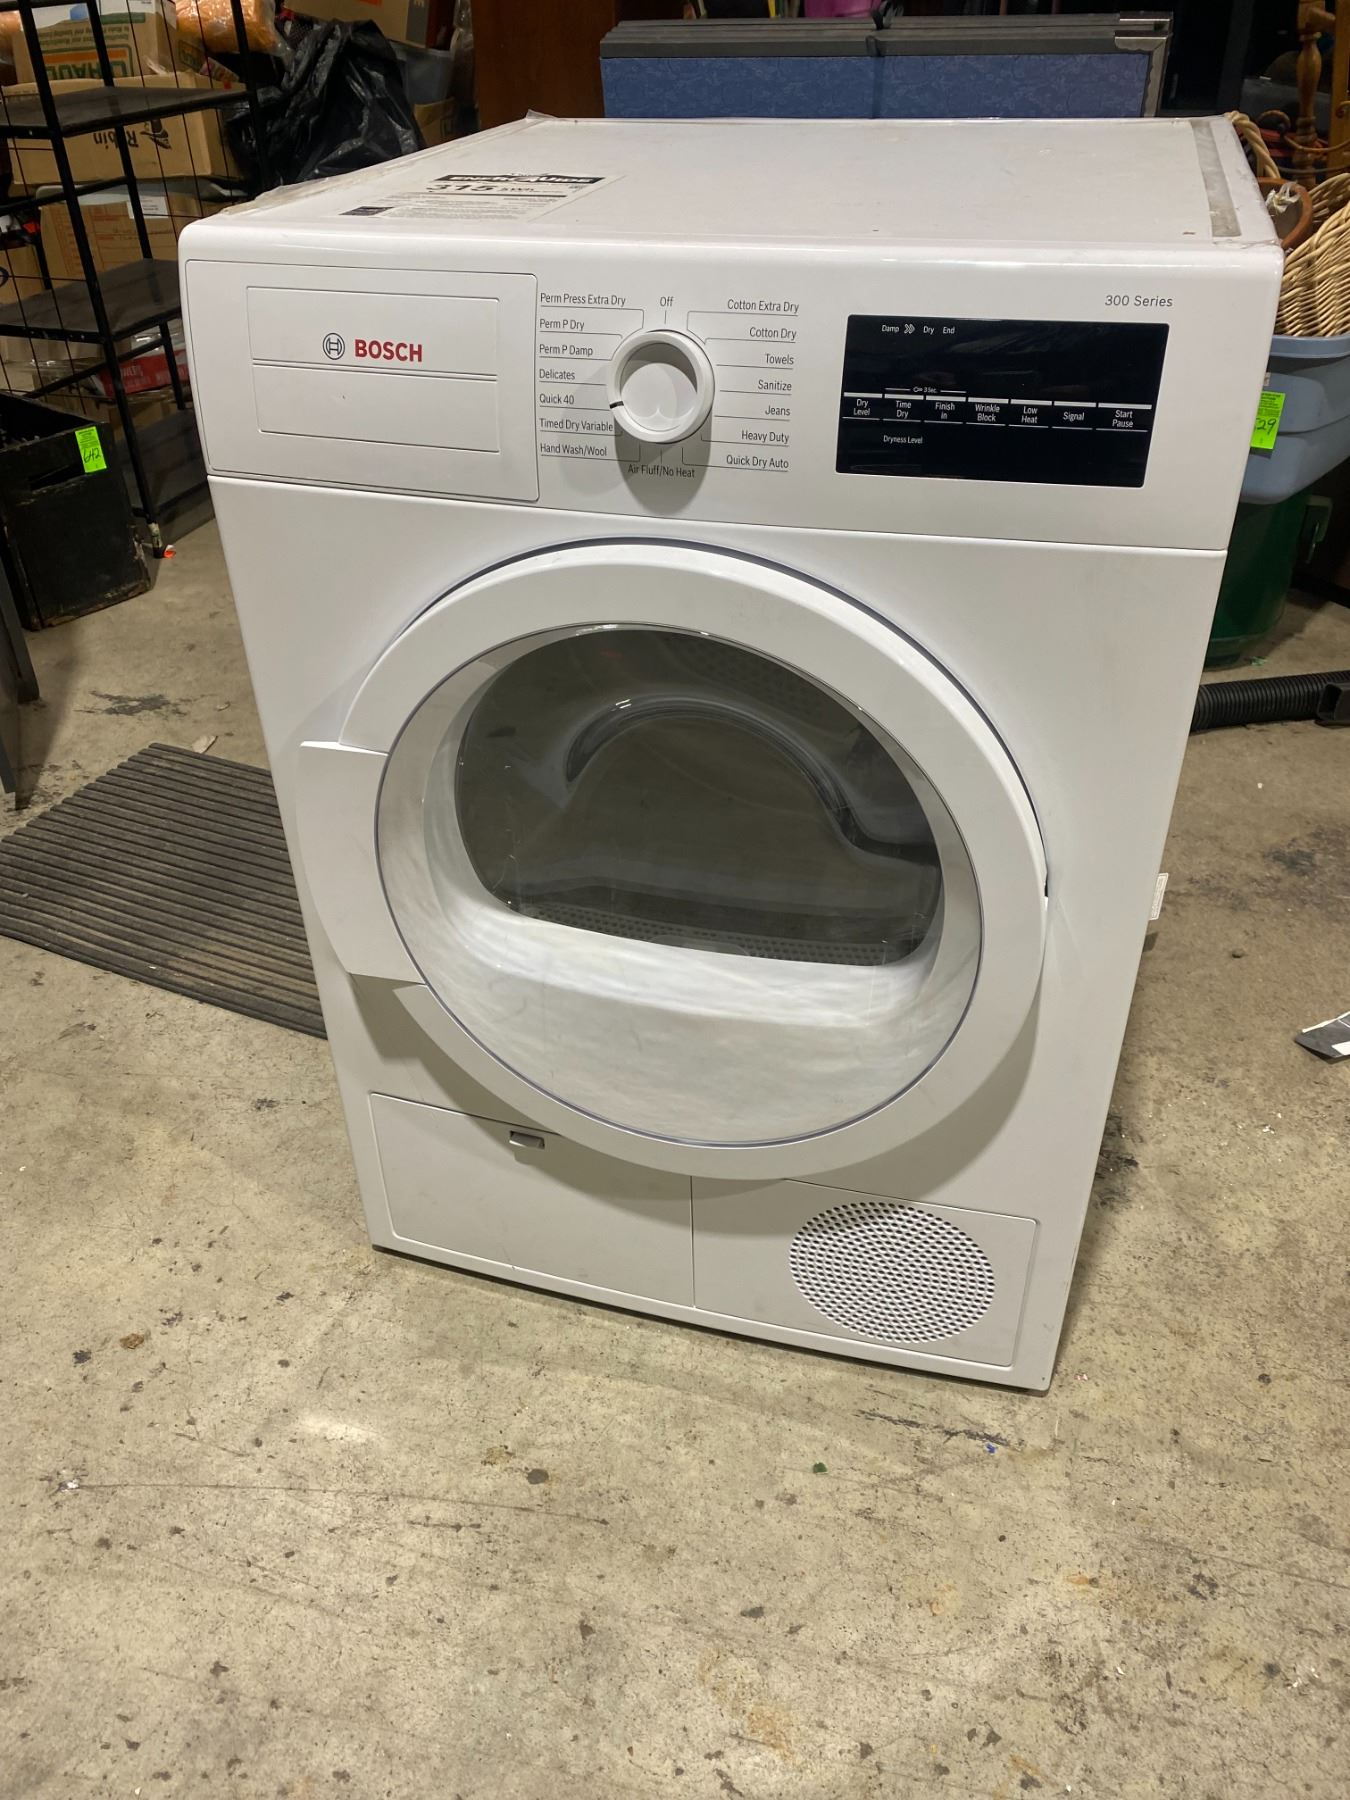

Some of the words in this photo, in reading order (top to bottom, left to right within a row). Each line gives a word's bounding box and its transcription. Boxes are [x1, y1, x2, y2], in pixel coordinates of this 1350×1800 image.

[93, 130, 139, 149] Rbin
[427, 184, 498, 192] 315
[540, 292, 562, 303] Perm
[563, 293, 586, 305] Press
[587, 294, 610, 306] Extra
[611, 295, 626, 308] Dry
[659, 296, 674, 307] Off
[1104, 294, 1130, 306] 300
[1133, 294, 1174, 307] Series
[727, 298, 757, 311] Cotton
[758, 300, 782, 312] Extra
[783, 301, 800, 314] Dry
[539, 318, 561, 329] Perm
[562, 319, 570, 329] P
[570, 319, 585, 332] Dry
[881, 324, 900, 333] Damp
[923, 326, 935, 335] Dry
[942, 326, 955, 335] End
[749, 326, 779, 338] Cotton
[780, 328, 797, 341] Dry
[354, 338, 423, 363] BOSCH
[539, 343, 561, 355] Perm
[561, 344, 568, 355] P
[569, 345, 594, 357] Damp
[764, 353, 795, 365] Towels
[539, 368, 576, 381] Delicates
[757, 379, 793, 392] Sanitize
[539, 393, 562, 405] Quick
[563, 394, 575, 405] 40
[856, 398, 869, 409] Dry
[896, 400, 912, 409] Time
[764, 405, 791, 416] Jeans
[853, 407, 871, 416] Level
[935, 401, 956, 412] Finish
[975, 404, 1001, 413] Wrinkle
[1023, 406, 1038, 414] Low
[896, 409, 909, 419] Dry
[977, 412, 997, 422] Block
[1021, 414, 1038, 424] Heat
[1063, 411, 1085, 422] Signal
[1115, 409, 1133, 419] Start
[539, 417, 564, 428] Timed
[565, 419, 580, 432] Dry
[581, 421, 614, 432] Variable
[1112, 418, 1134, 428] Pause
[741, 429, 768, 443] Heavy
[769, 431, 790, 444] Duty
[883, 435, 907, 444] Dryness
[907, 436, 923, 444] Level
[540, 443, 561, 454] Hand
[562, 444, 608, 457] Wash/Wool
[726, 454, 751, 466] Quick
[752, 456, 768, 470] Dry
[769, 457, 790, 469] Auto
[627, 463, 640, 474] Air
[641, 464, 675, 477] Fluff/No
[676, 467, 696, 478] Heat
